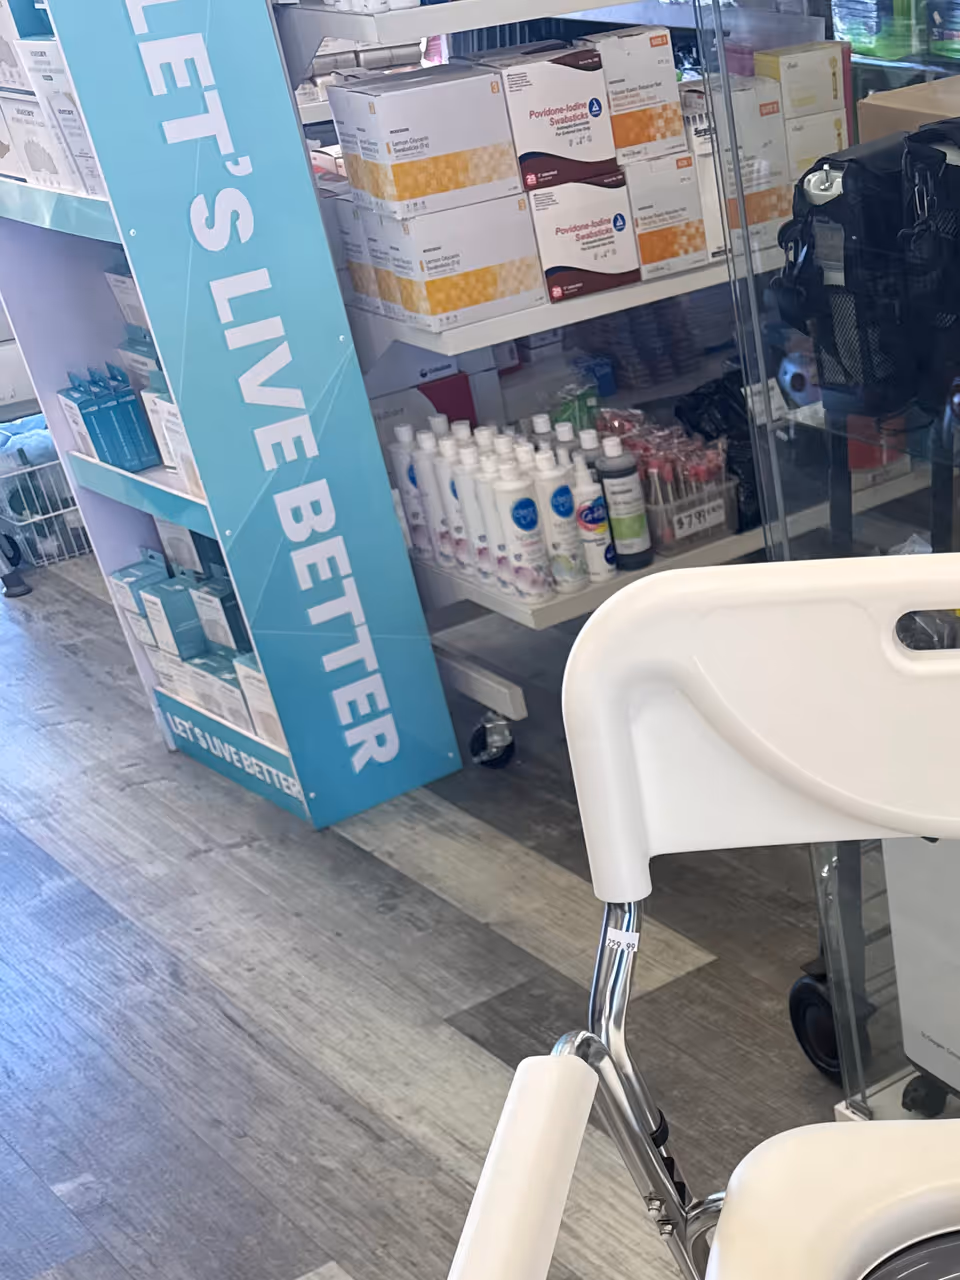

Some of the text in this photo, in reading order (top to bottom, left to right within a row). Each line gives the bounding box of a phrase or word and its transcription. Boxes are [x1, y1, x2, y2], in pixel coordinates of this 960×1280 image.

[529, 101, 587, 119] Povidone-Iodine
[549, 111, 588, 126] Swabsticks
[209, 267, 321, 472] LIVE
[273, 479, 400, 774] BETTER
[204, 731, 242, 769] LIVE
[239, 751, 303, 802] BETTER
